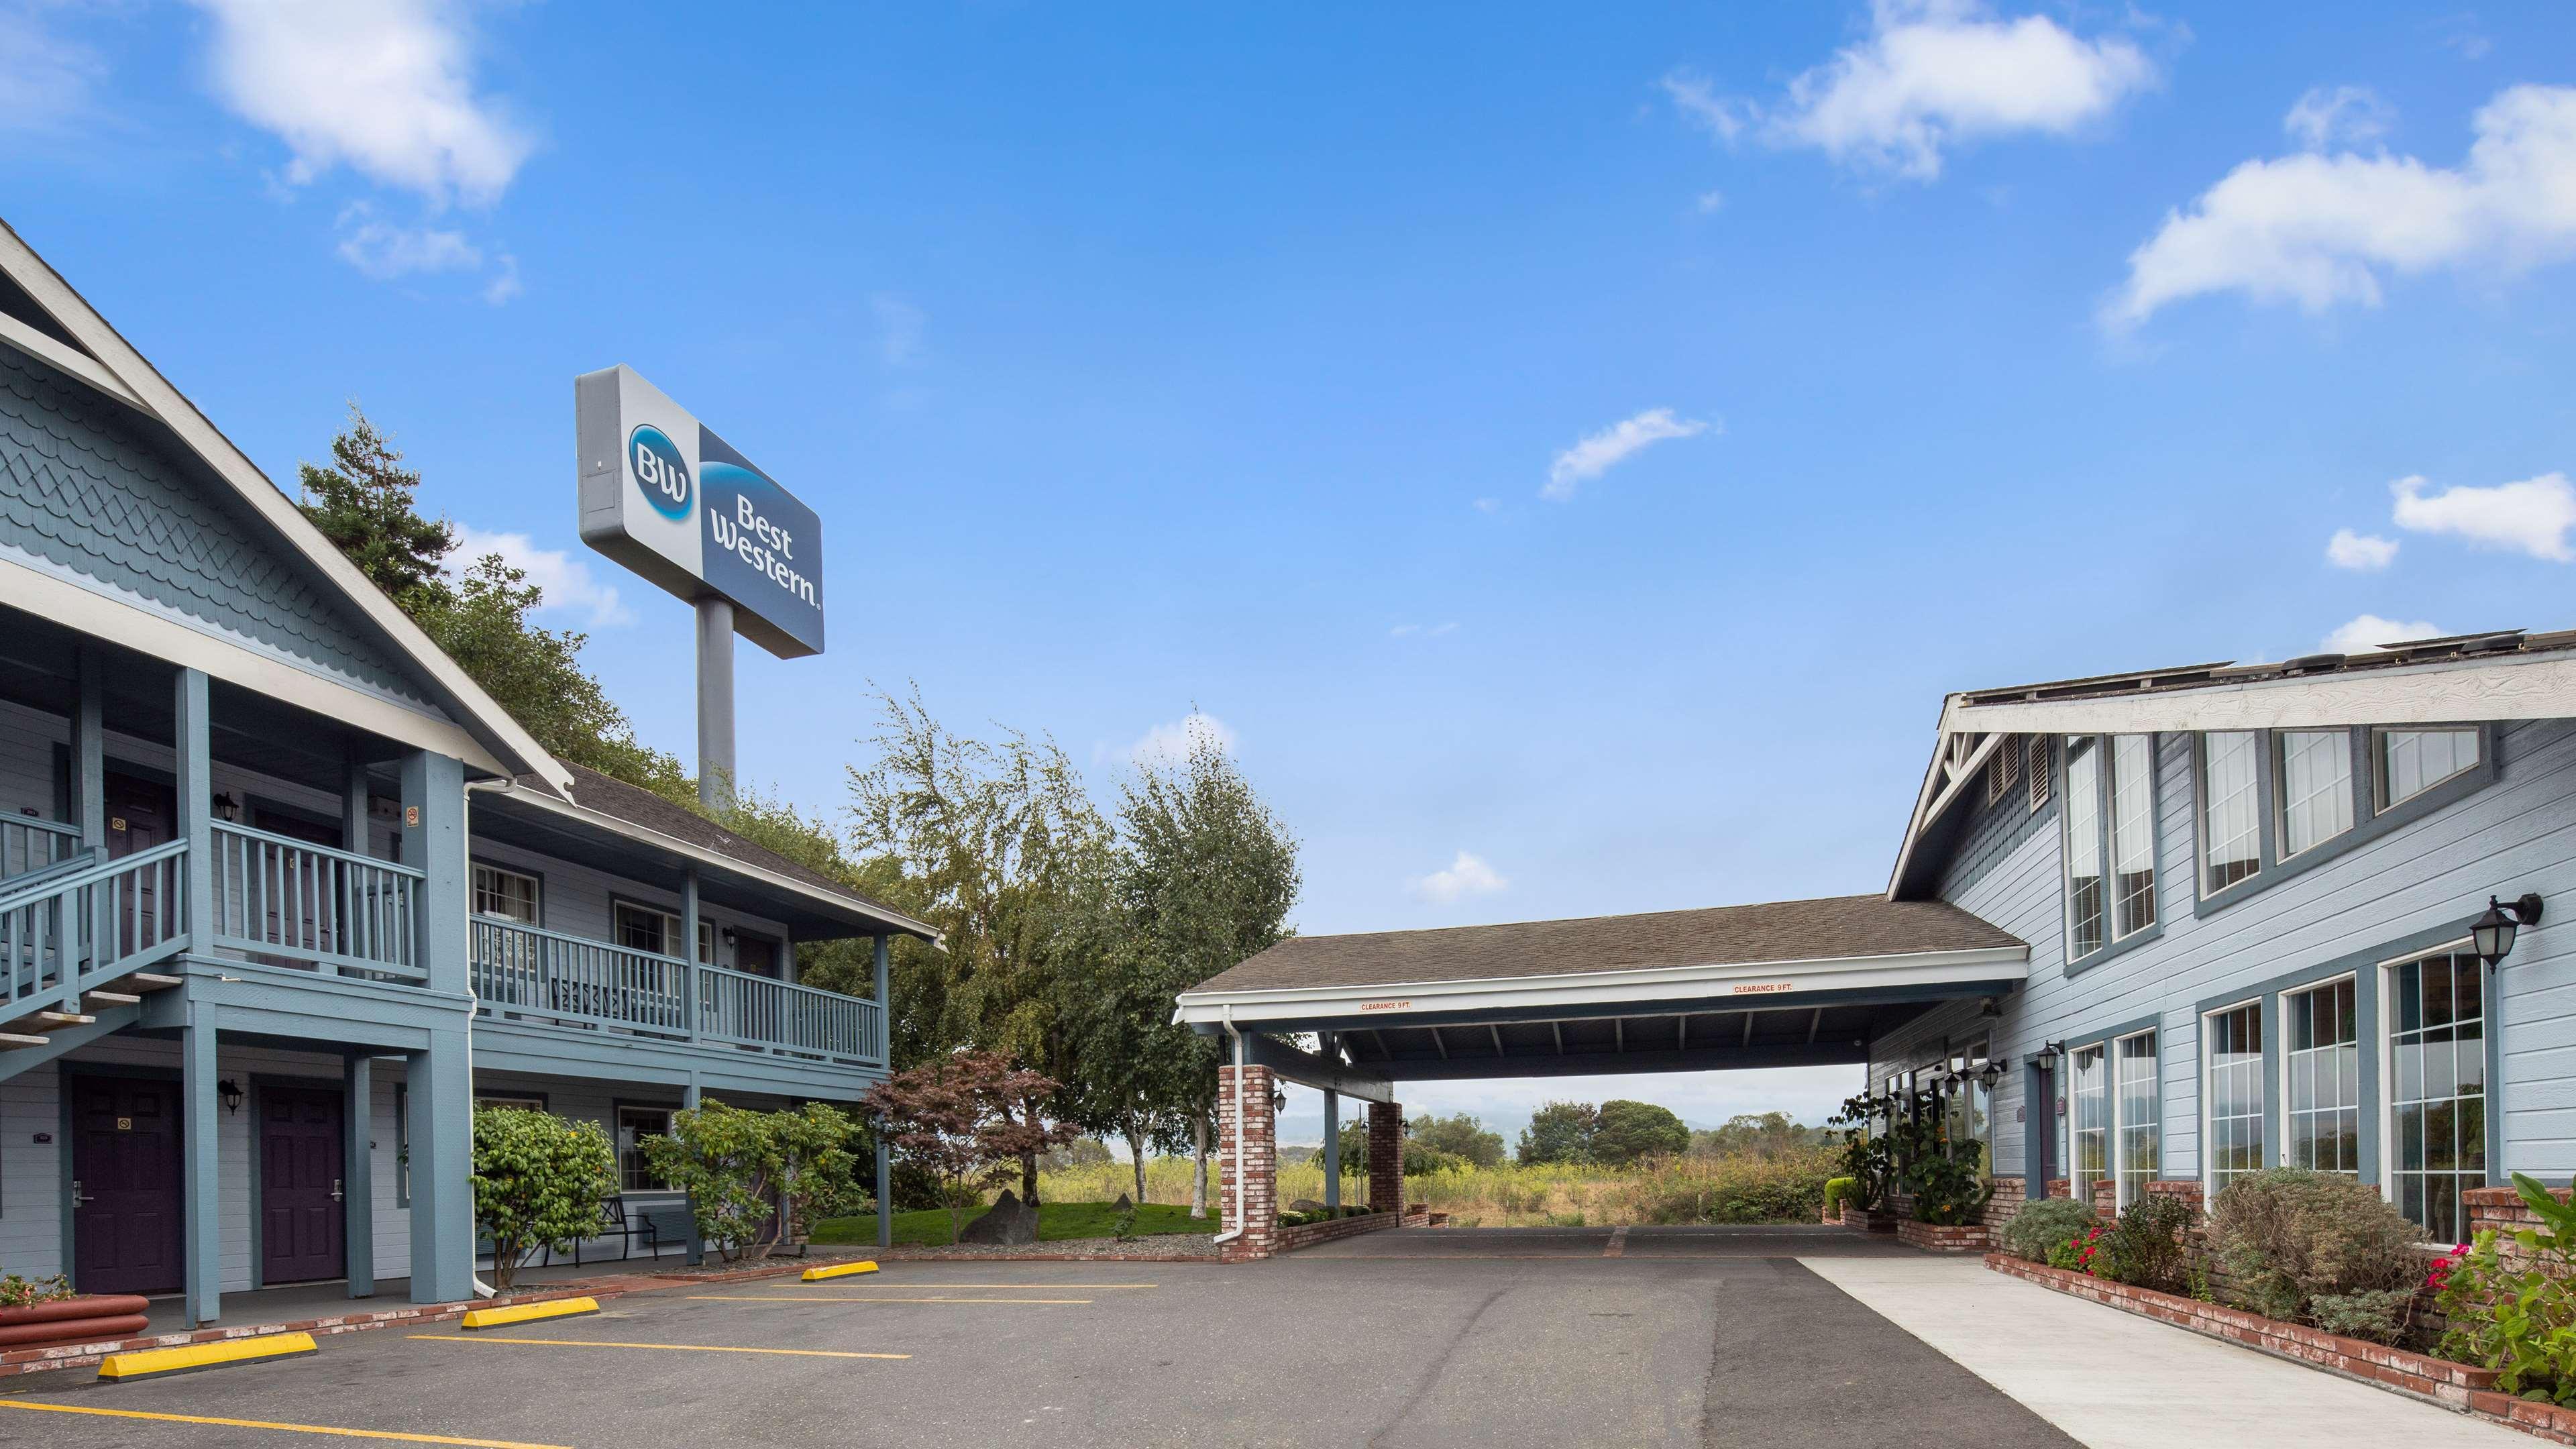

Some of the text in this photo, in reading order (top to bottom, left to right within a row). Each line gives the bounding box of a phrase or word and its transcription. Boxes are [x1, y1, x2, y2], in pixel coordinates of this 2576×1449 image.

[637, 442, 687, 502] BW
[738, 493, 793, 560] Best
[1735, 985, 1775, 993] CLEARANCE
